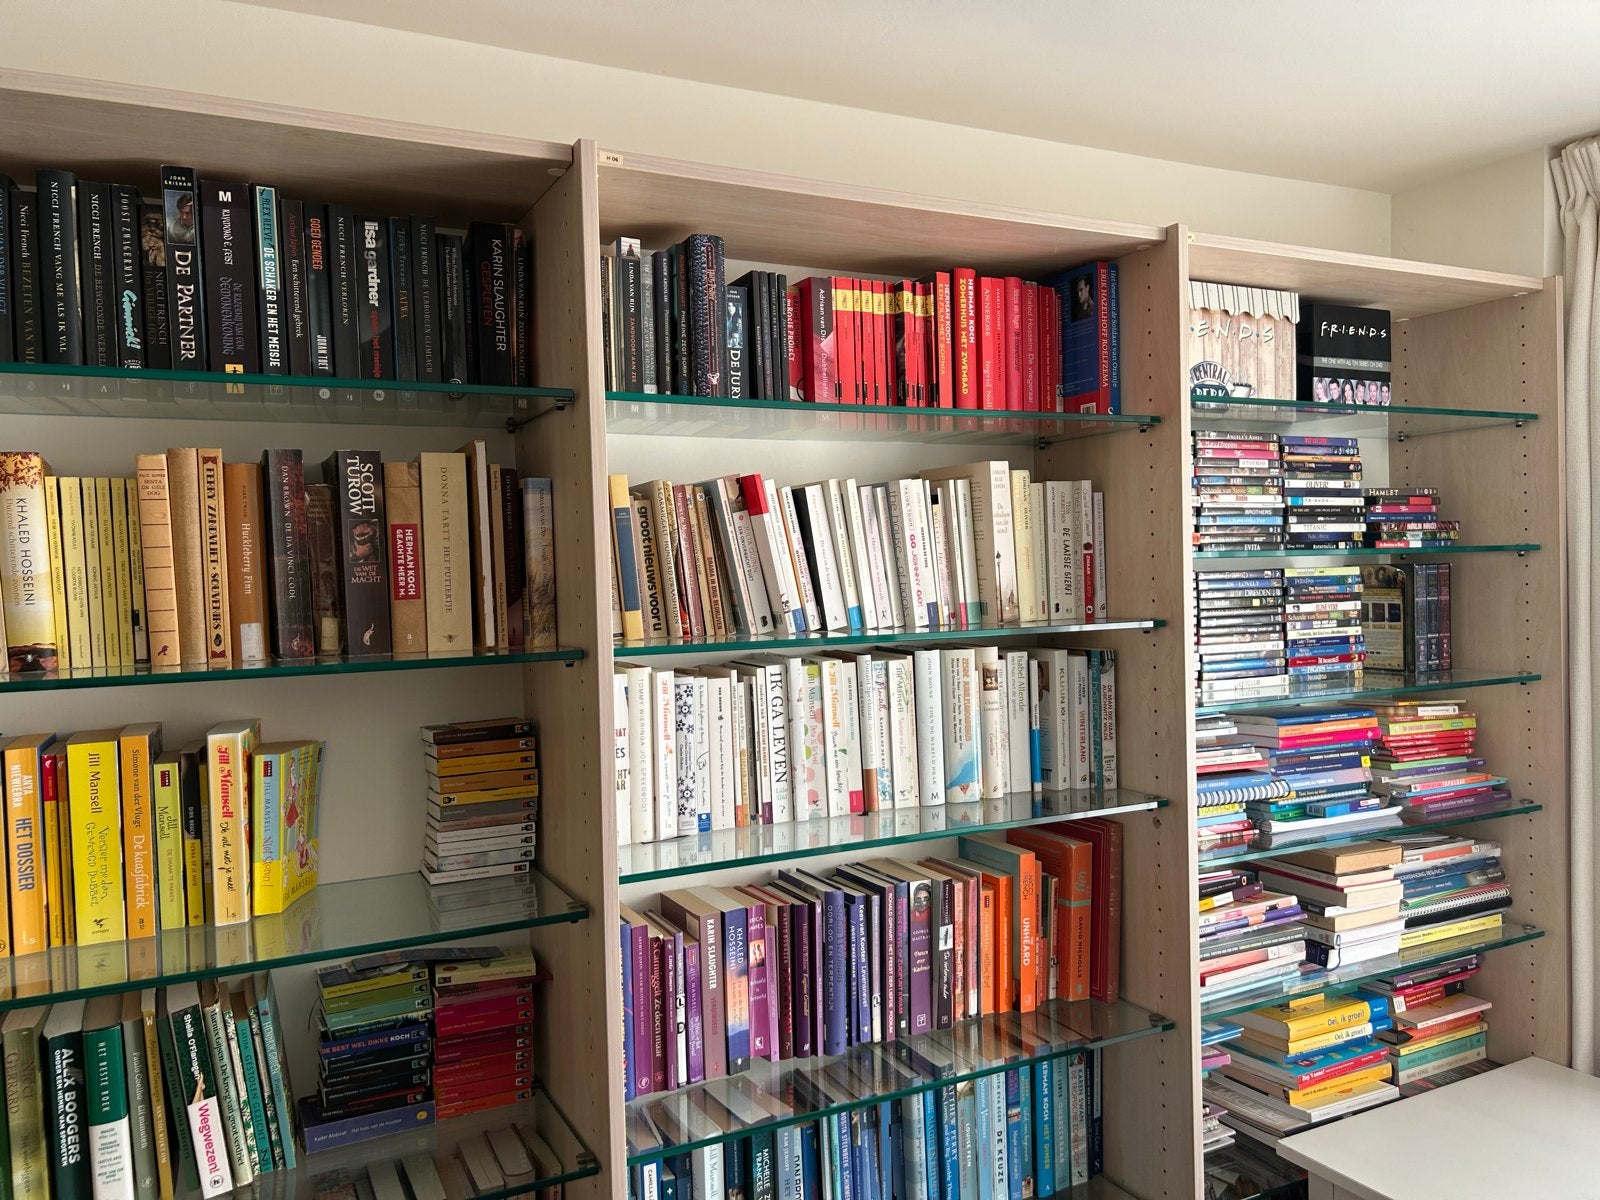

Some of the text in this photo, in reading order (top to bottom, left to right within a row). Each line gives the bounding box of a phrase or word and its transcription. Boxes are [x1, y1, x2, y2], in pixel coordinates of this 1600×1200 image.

[50, 181, 59, 209] NICCI
[53, 212, 62, 250] FRENCH
[54, 254, 63, 279] VANG
[364, 221, 380, 306] lisa gardner
[56, 283, 64, 297] ME
[175, 251, 196, 360] DE PARTNER
[263, 247, 280, 367] DE SCHAKER EN HET MEISJE
[291, 259, 303, 338] Een schitterend gebrek
[492, 239, 507, 351] KARIN SLAUGHTER
[58, 321, 66, 332] IK
[730, 350, 741, 367] DE
[1194, 361, 1226, 385] CENTRAL
[347, 456, 362, 515] TUROW
[360, 463, 375, 512] SCOTT
[440, 467, 449, 504] DONNA
[206, 468, 221, 630] FERRY ZANDVLIET SOUVENIRS
[441, 510, 450, 541] TARTT
[909, 534, 917, 549] GO
[16, 498, 36, 606] KHALED HOSSEINI
[241, 523, 253, 594] Huckleberry Finn
[396, 529, 406, 598] GEACHTE HEER M.
[405, 529, 416, 595] HERMAN KOCH
[911, 550, 921, 586] JOHNNY
[1062, 528, 1072, 596] DE LAATSTE STERFT
[444, 566, 452, 613] PUTTERTJE
[713, 599, 722, 630] BEDRIJVEN
[770, 672, 788, 783] IK GA LEVEN
[10, 764, 25, 808] NIEWIERRA
[23, 775, 33, 794] ANYA
[88, 753, 102, 814] Jill Mansell
[132, 749, 141, 778] Simone
[217, 745, 234, 818] Jill Mansell
[133, 806, 142, 828] Vlugt
[16, 818, 35, 891] HET DOSSIER
[134, 834, 145, 850] De
[131, 851, 149, 908] kaasfabriek
[706, 919, 717, 989] KARIN SLAUGHTER
[828, 946, 833, 956] EN
[654, 999, 661, 1010] Ze
[654, 1012, 662, 1034] doen
[1328, 1016, 1338, 1026] Oei,
[1348, 1010, 1364, 1022] groei!
[183, 1014, 201, 1080] Sheila O'Flanagan
[332, 1044, 350, 1053] BEST
[351, 1042, 366, 1050] WEL
[368, 1037, 390, 1047] DIKKE
[390, 1032, 410, 1042] KOCH
[1335, 1032, 1344, 1040] Oei,
[98, 1042, 110, 1112] HET BESTE BOEK
[54, 1050, 62, 1074] ONDER
[58, 1130, 68, 1166] SPROETEN
[64, 1091, 81, 1164] BOOGERS
[198, 1103, 220, 1174] Wegwezen!
[997, 1131, 1002, 1144] DE
